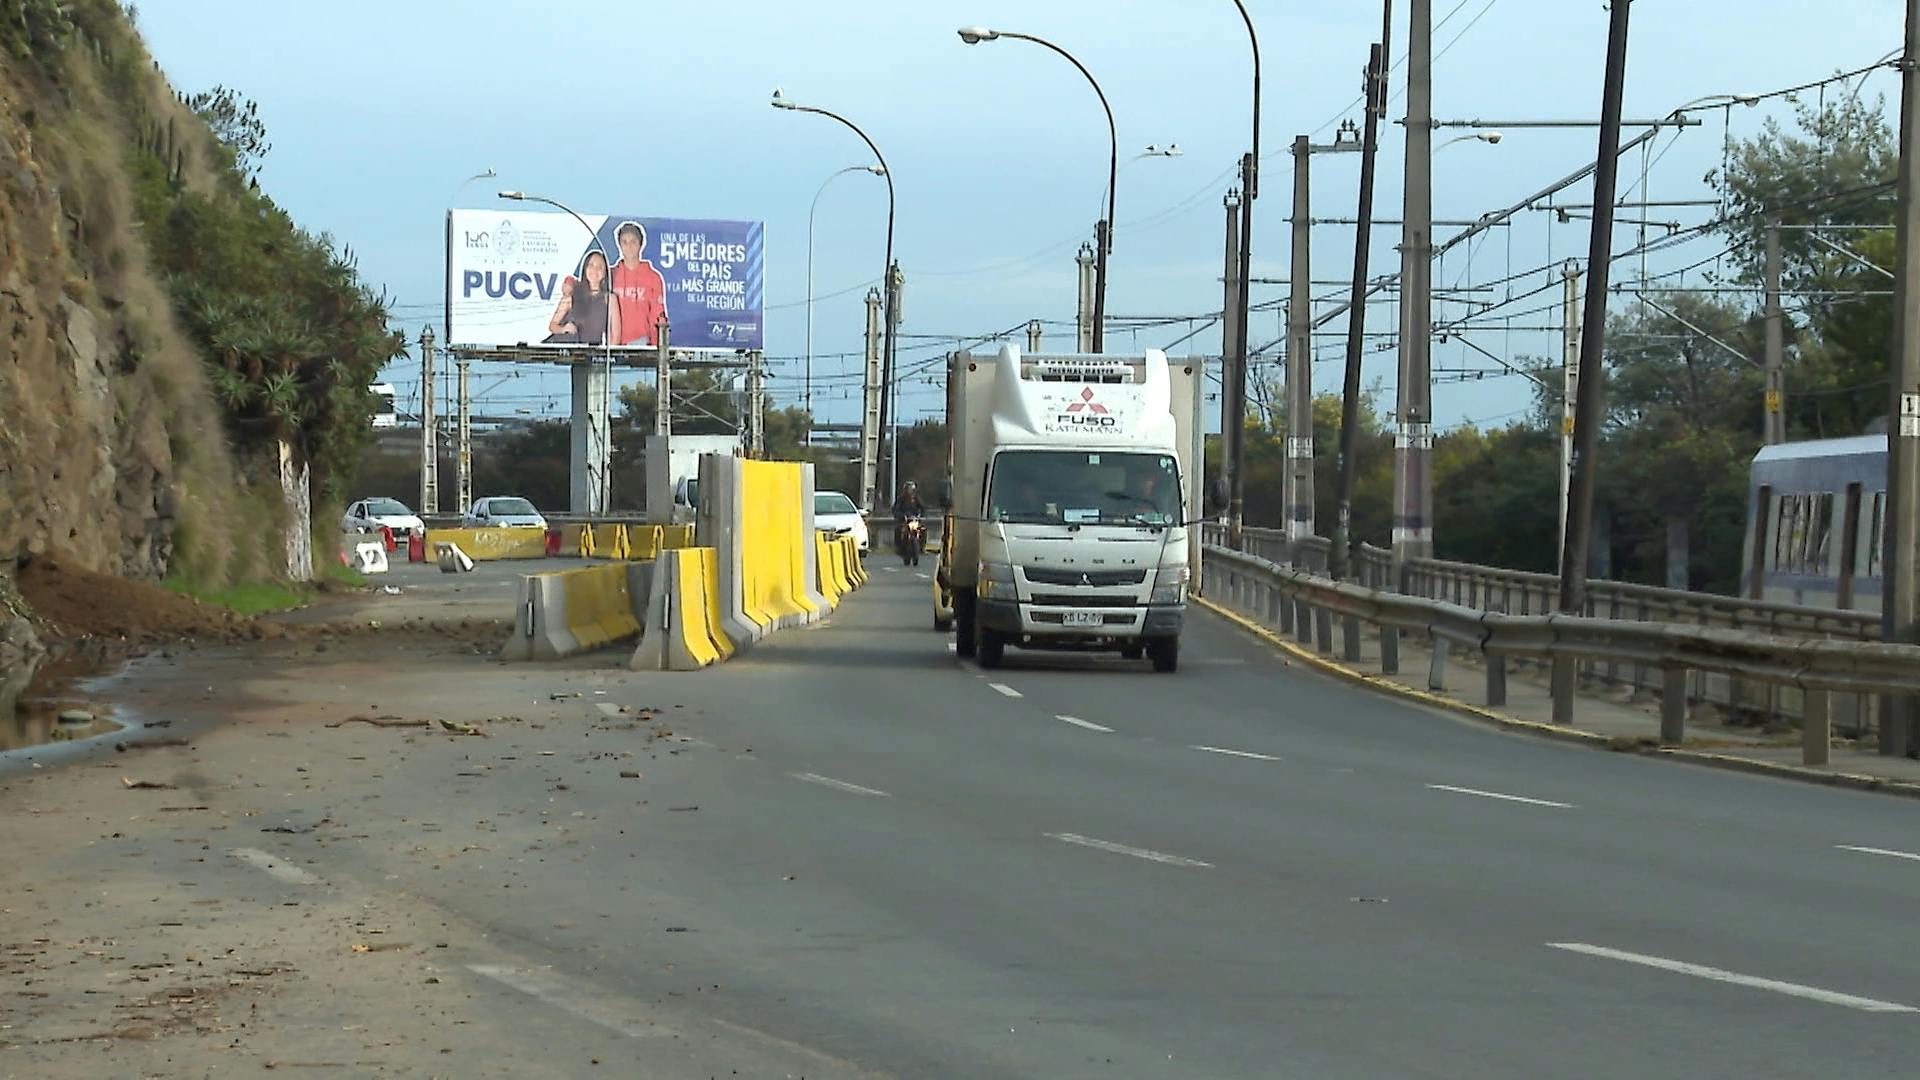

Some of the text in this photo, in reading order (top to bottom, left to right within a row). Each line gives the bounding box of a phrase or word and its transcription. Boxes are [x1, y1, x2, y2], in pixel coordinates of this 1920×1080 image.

[679, 233, 688, 242] DE
[691, 233, 706, 243] LAS
[660, 241, 745, 269] 5 MEJORES
[687, 261, 731, 280] DEL PAÍS
[463, 269, 558, 300] PUCV
[673, 283, 681, 292] LA
[682, 276, 704, 292] MÁS
[706, 279, 745, 294] GRANDE
[706, 294, 745, 311] REGIÓN
[727, 324, 735, 337] 7
[1058, 415, 1115, 426] FUSO
